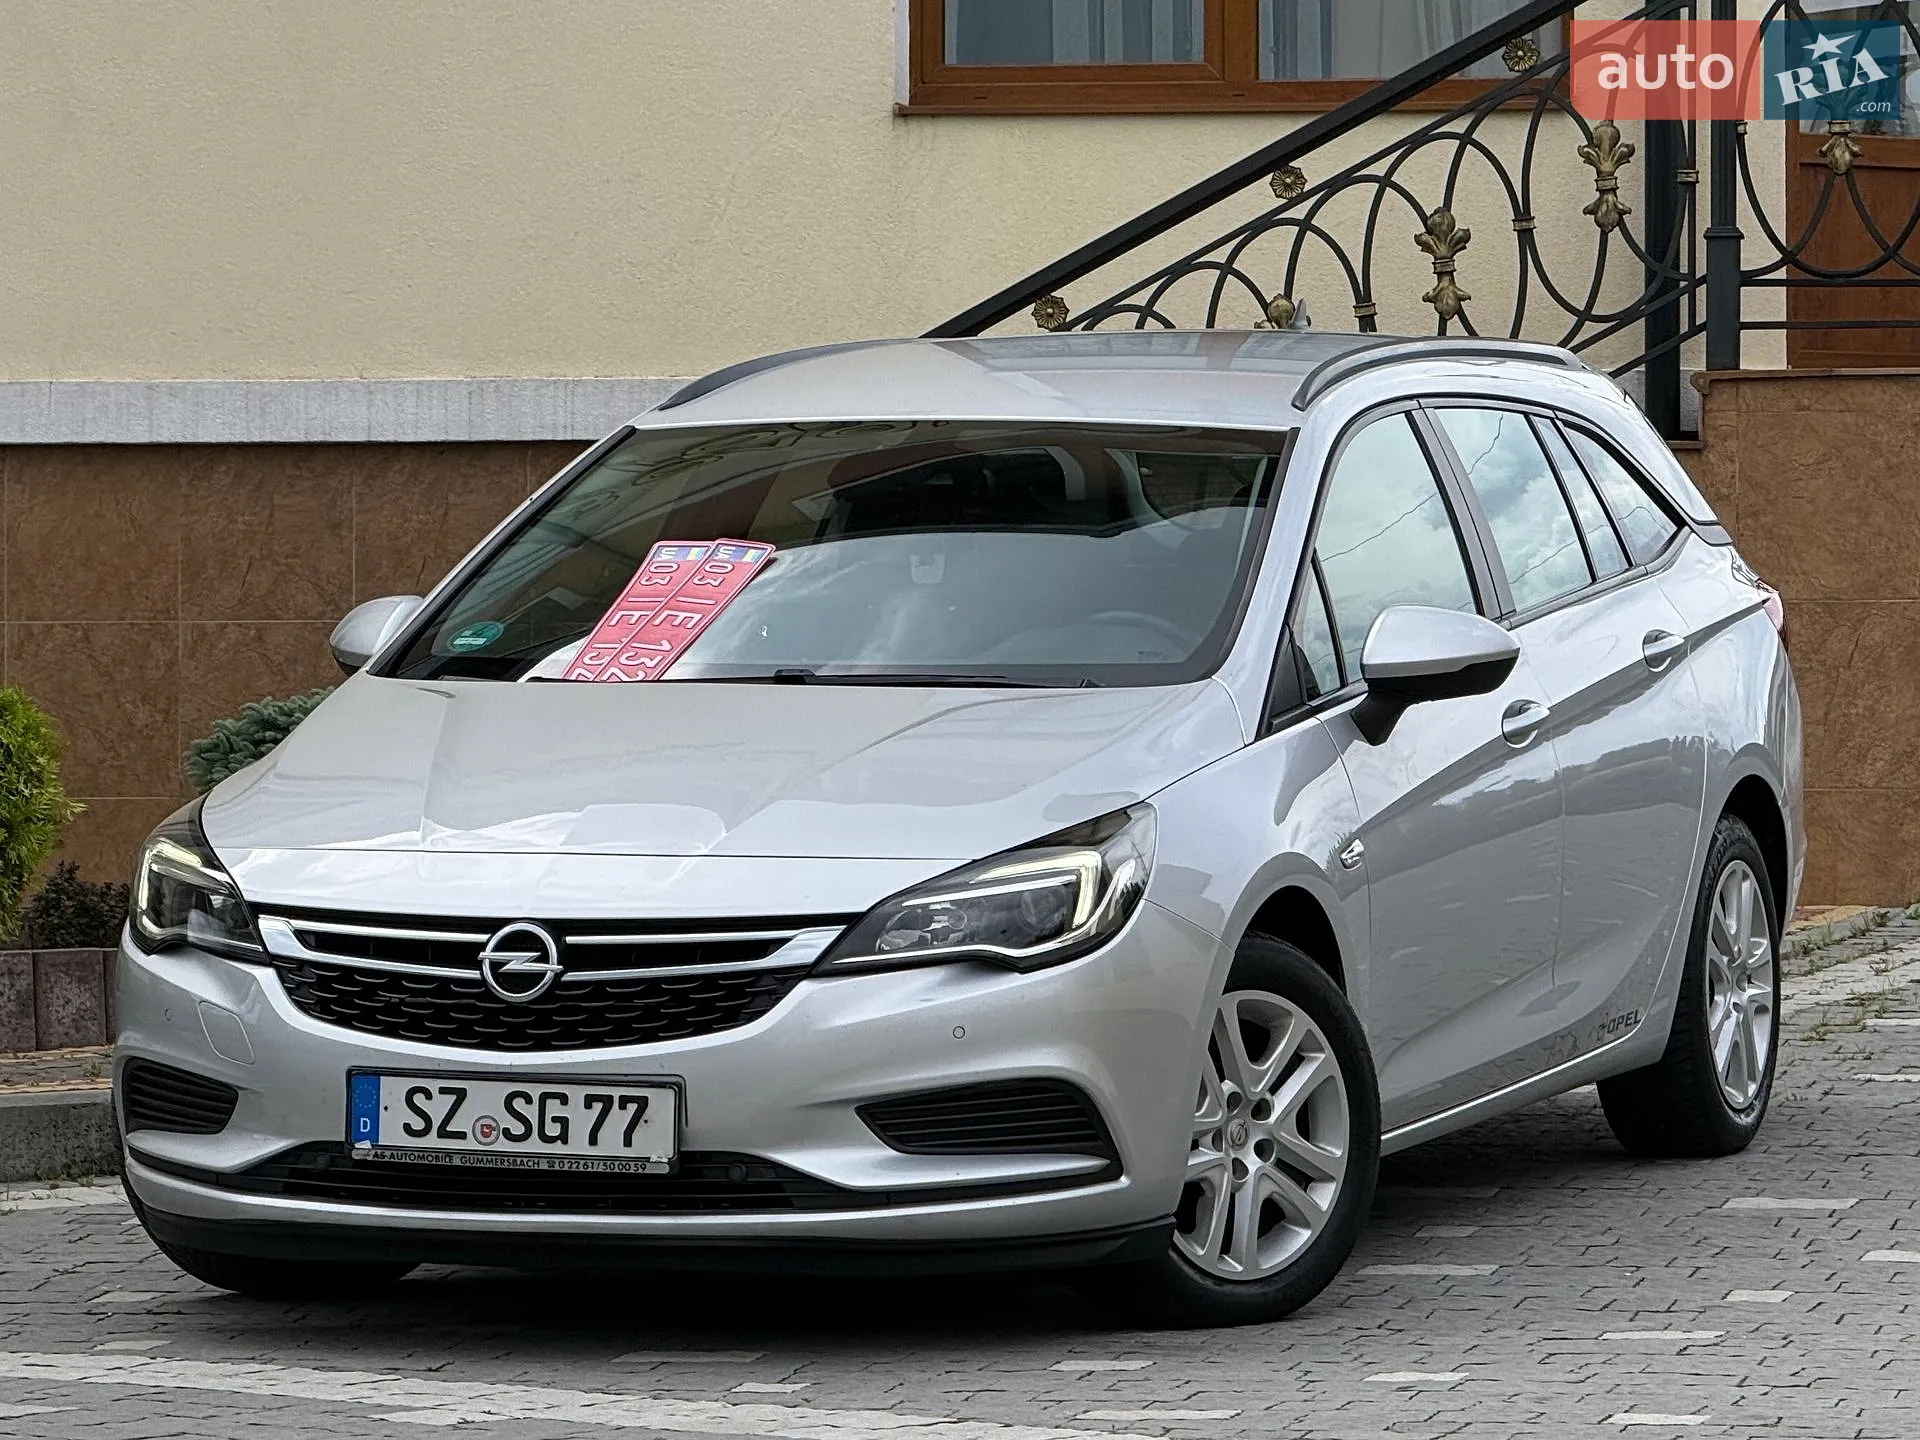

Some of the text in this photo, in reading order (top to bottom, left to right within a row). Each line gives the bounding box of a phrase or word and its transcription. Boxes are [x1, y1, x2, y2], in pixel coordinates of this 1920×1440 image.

[402, 1085, 650, 1148] SZ SG 77
[360, 1118, 371, 1133] D
[460, 1156, 541, 1169] GUMMERSBACH
